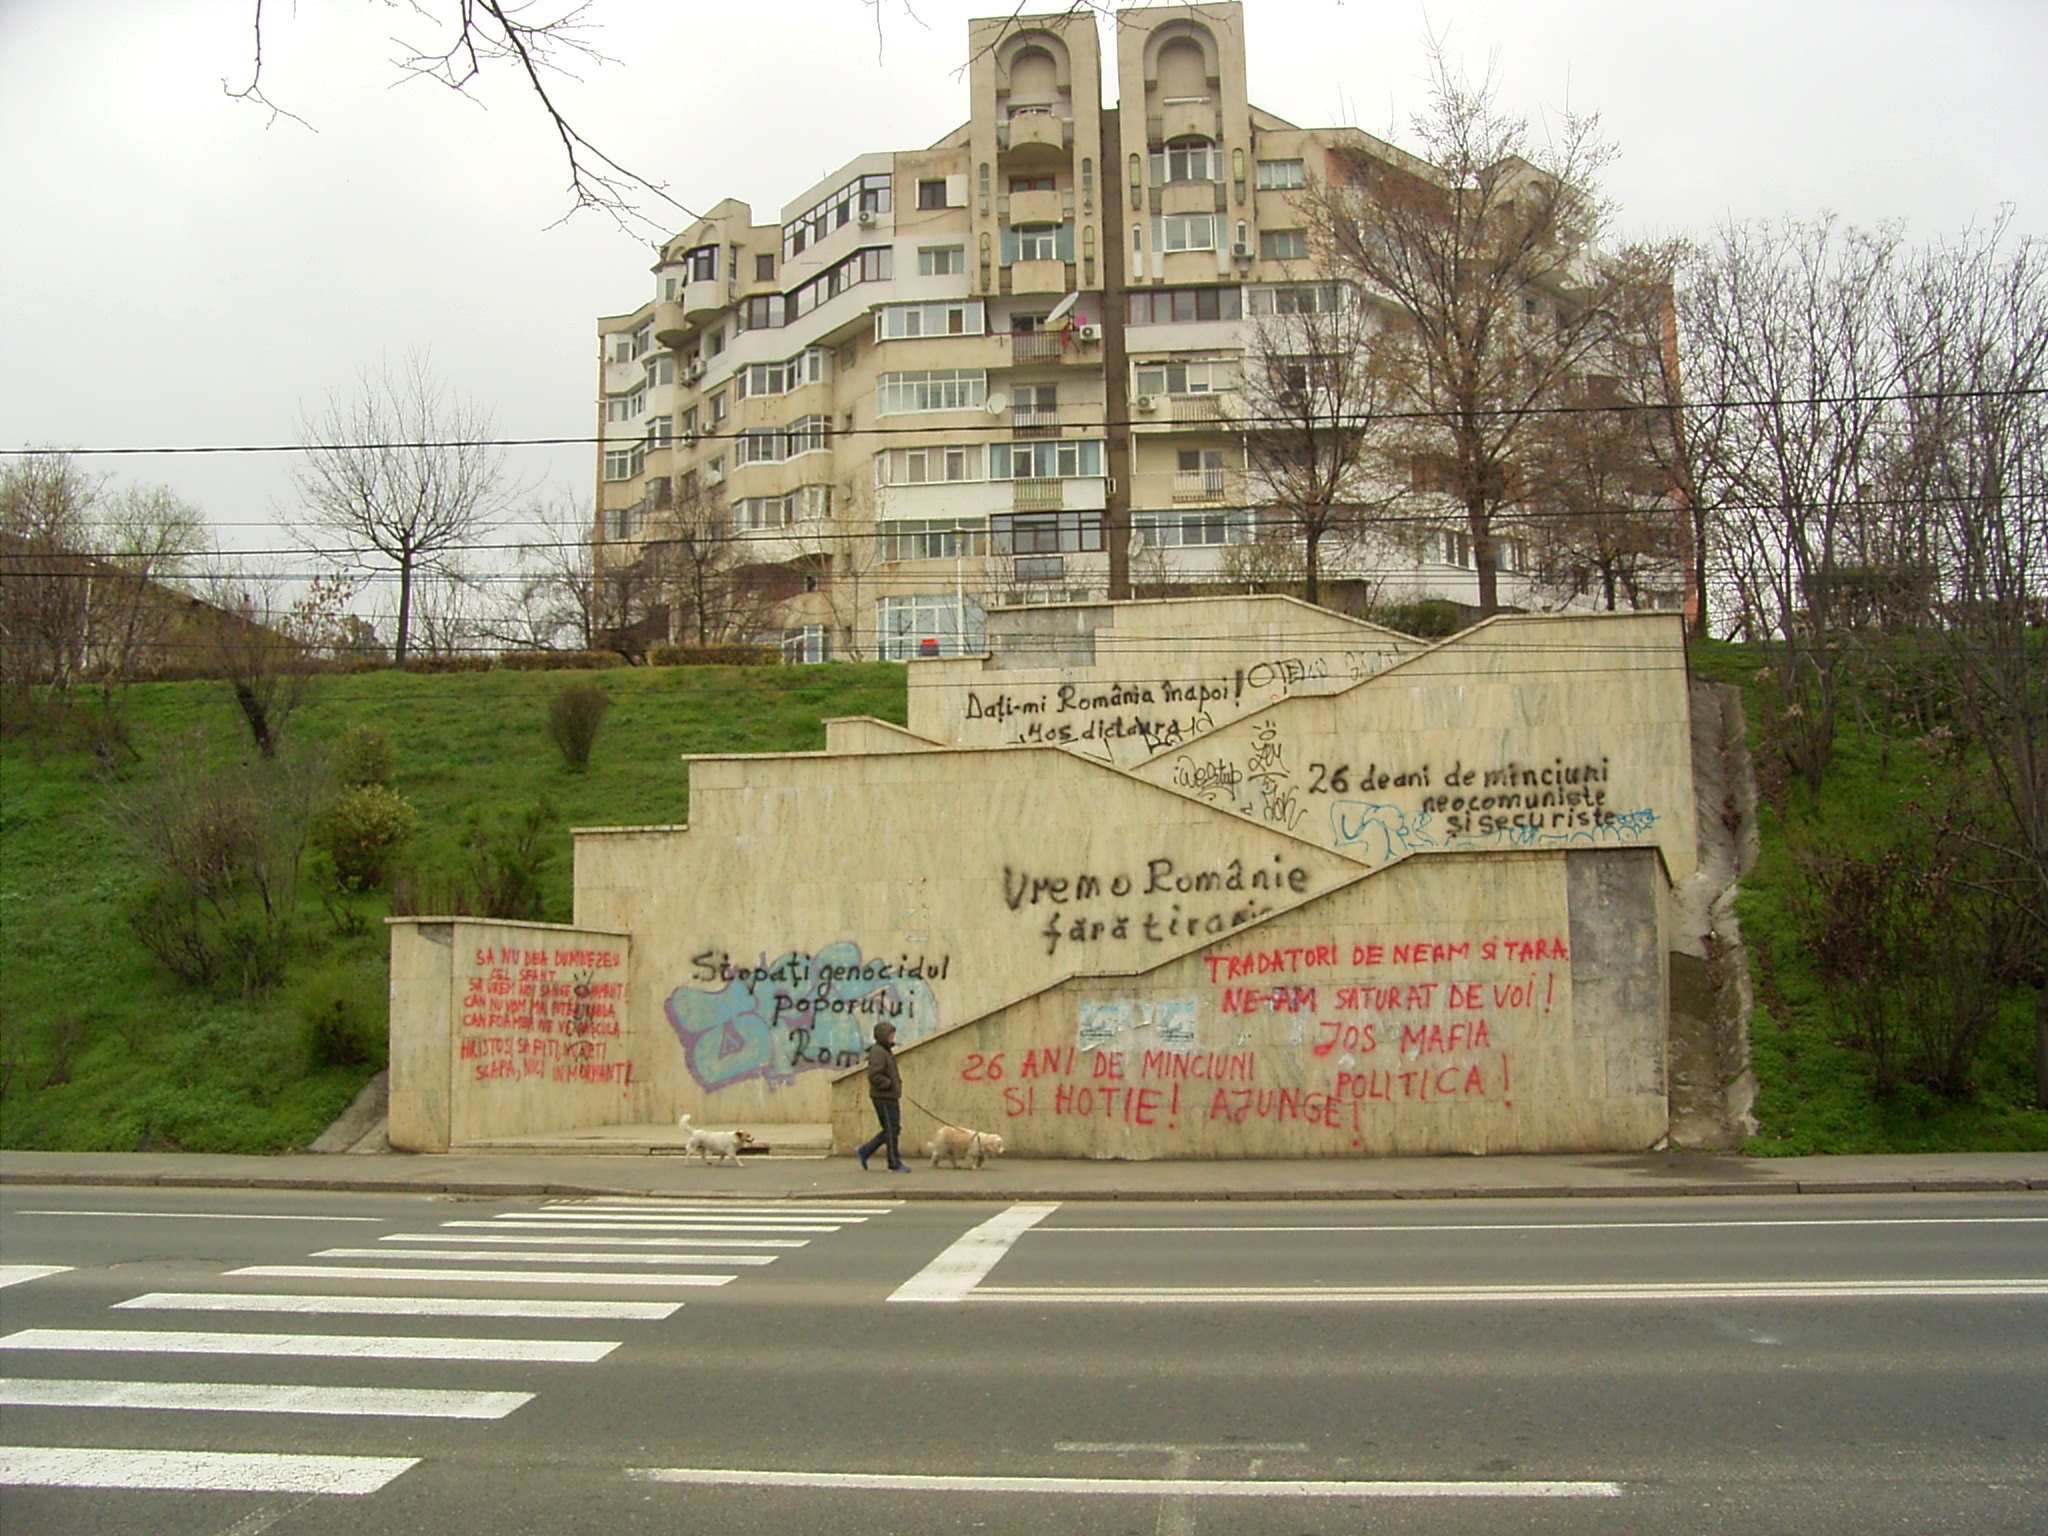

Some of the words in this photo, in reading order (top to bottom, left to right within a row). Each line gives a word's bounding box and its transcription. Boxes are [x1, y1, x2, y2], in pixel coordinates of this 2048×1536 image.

[1057, 684, 1154, 713] România
[1308, 763, 1349, 794] 26
[1444, 761, 1476, 788] de
[1484, 758, 1609, 788] minciuni
[1422, 787, 1606, 814] neocomuniste
[1144, 855, 1309, 894] Românie
[818, 954, 949, 997] genocidul
[1204, 944, 1338, 984] TRADATORI
[1352, 945, 1384, 966] DE
[1393, 941, 1469, 966] NEAM
[772, 990, 915, 1030] poporului
[1334, 982, 1439, 1011] SATURAT
[1449, 983, 1484, 1010] DE
[1311, 1022, 1376, 1057] JOS
[1400, 1018, 1491, 1055] MAFIA
[961, 1052, 1006, 1082] 26
[1020, 1045, 1076, 1079] ANI
[1093, 1051, 1125, 1080] DE
[1142, 1050, 1256, 1082] MINCIUNI
[1002, 1085, 1034, 1118] SI
